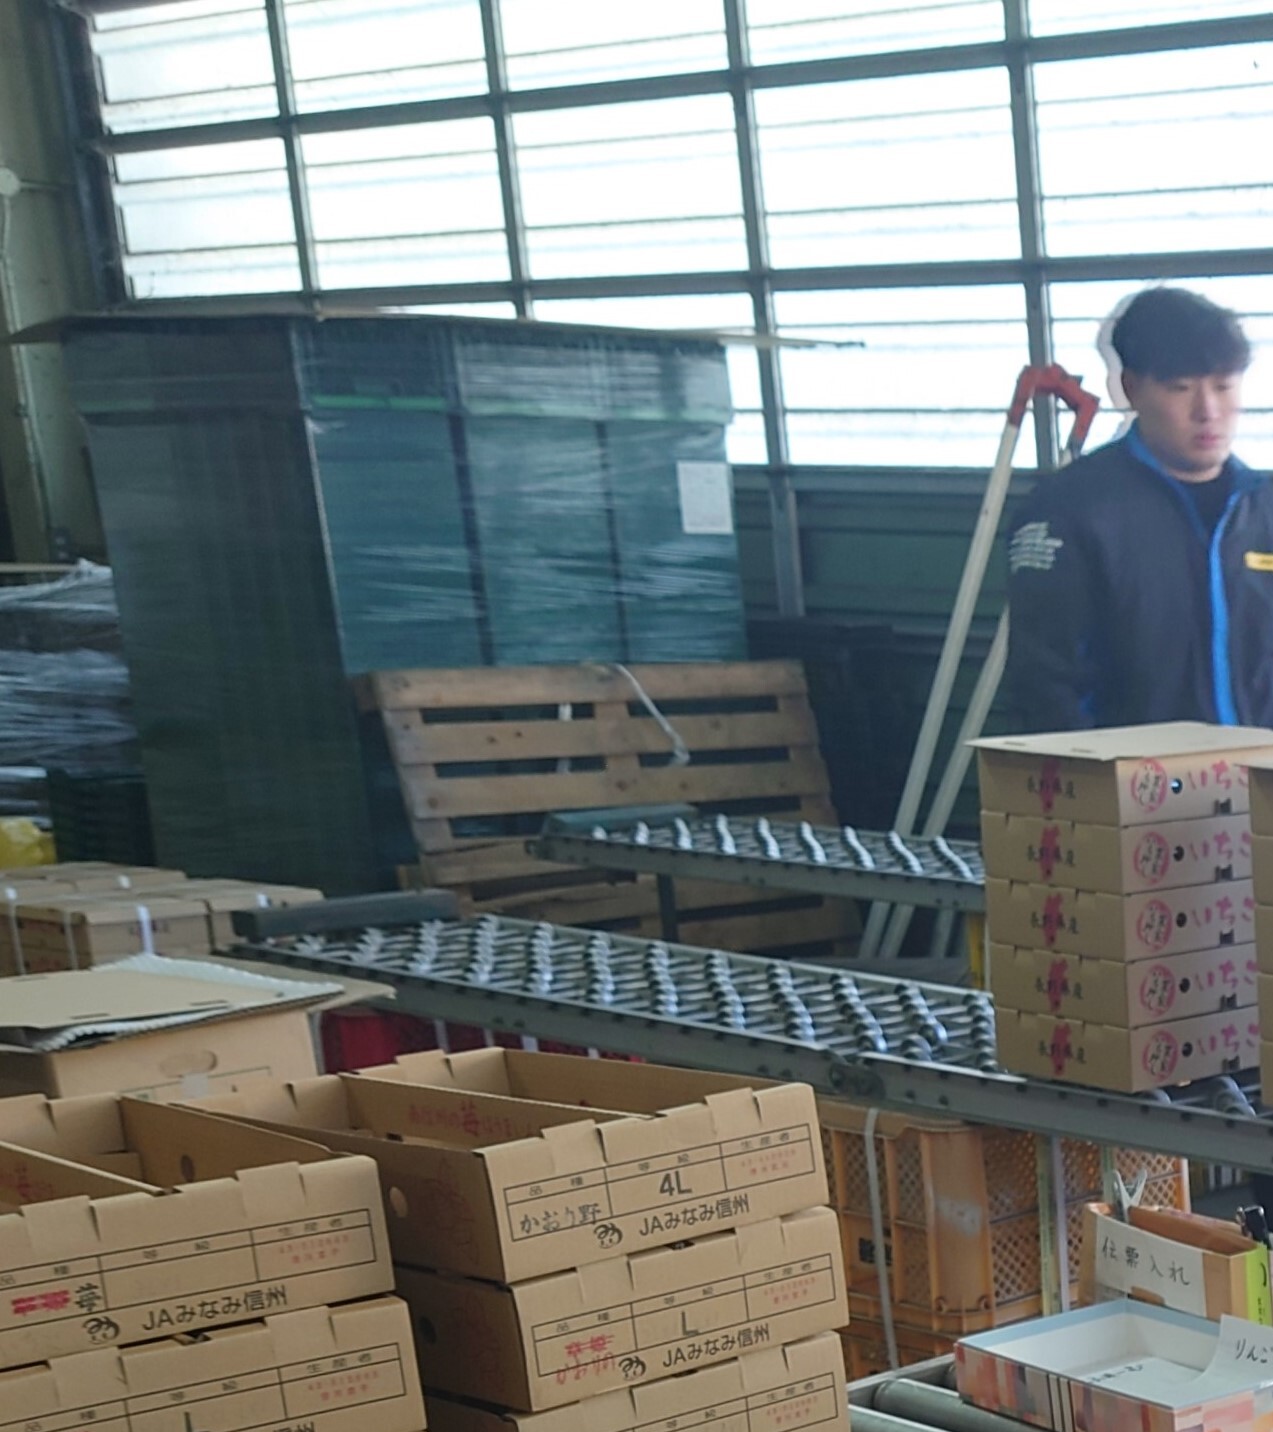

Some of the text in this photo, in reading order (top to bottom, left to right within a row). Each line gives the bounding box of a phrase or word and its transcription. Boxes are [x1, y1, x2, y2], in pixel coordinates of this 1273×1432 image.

[658, 1170, 693, 1197] 4L
[639, 1193, 750, 1237] JAみなみ信州
[1102, 1236, 1191, 1287] 伝票入れ
[142, 1285, 288, 1331] JAみなみ信州
[681, 1310, 699, 1337] L
[662, 1323, 770, 1368] JAみなみ信州
